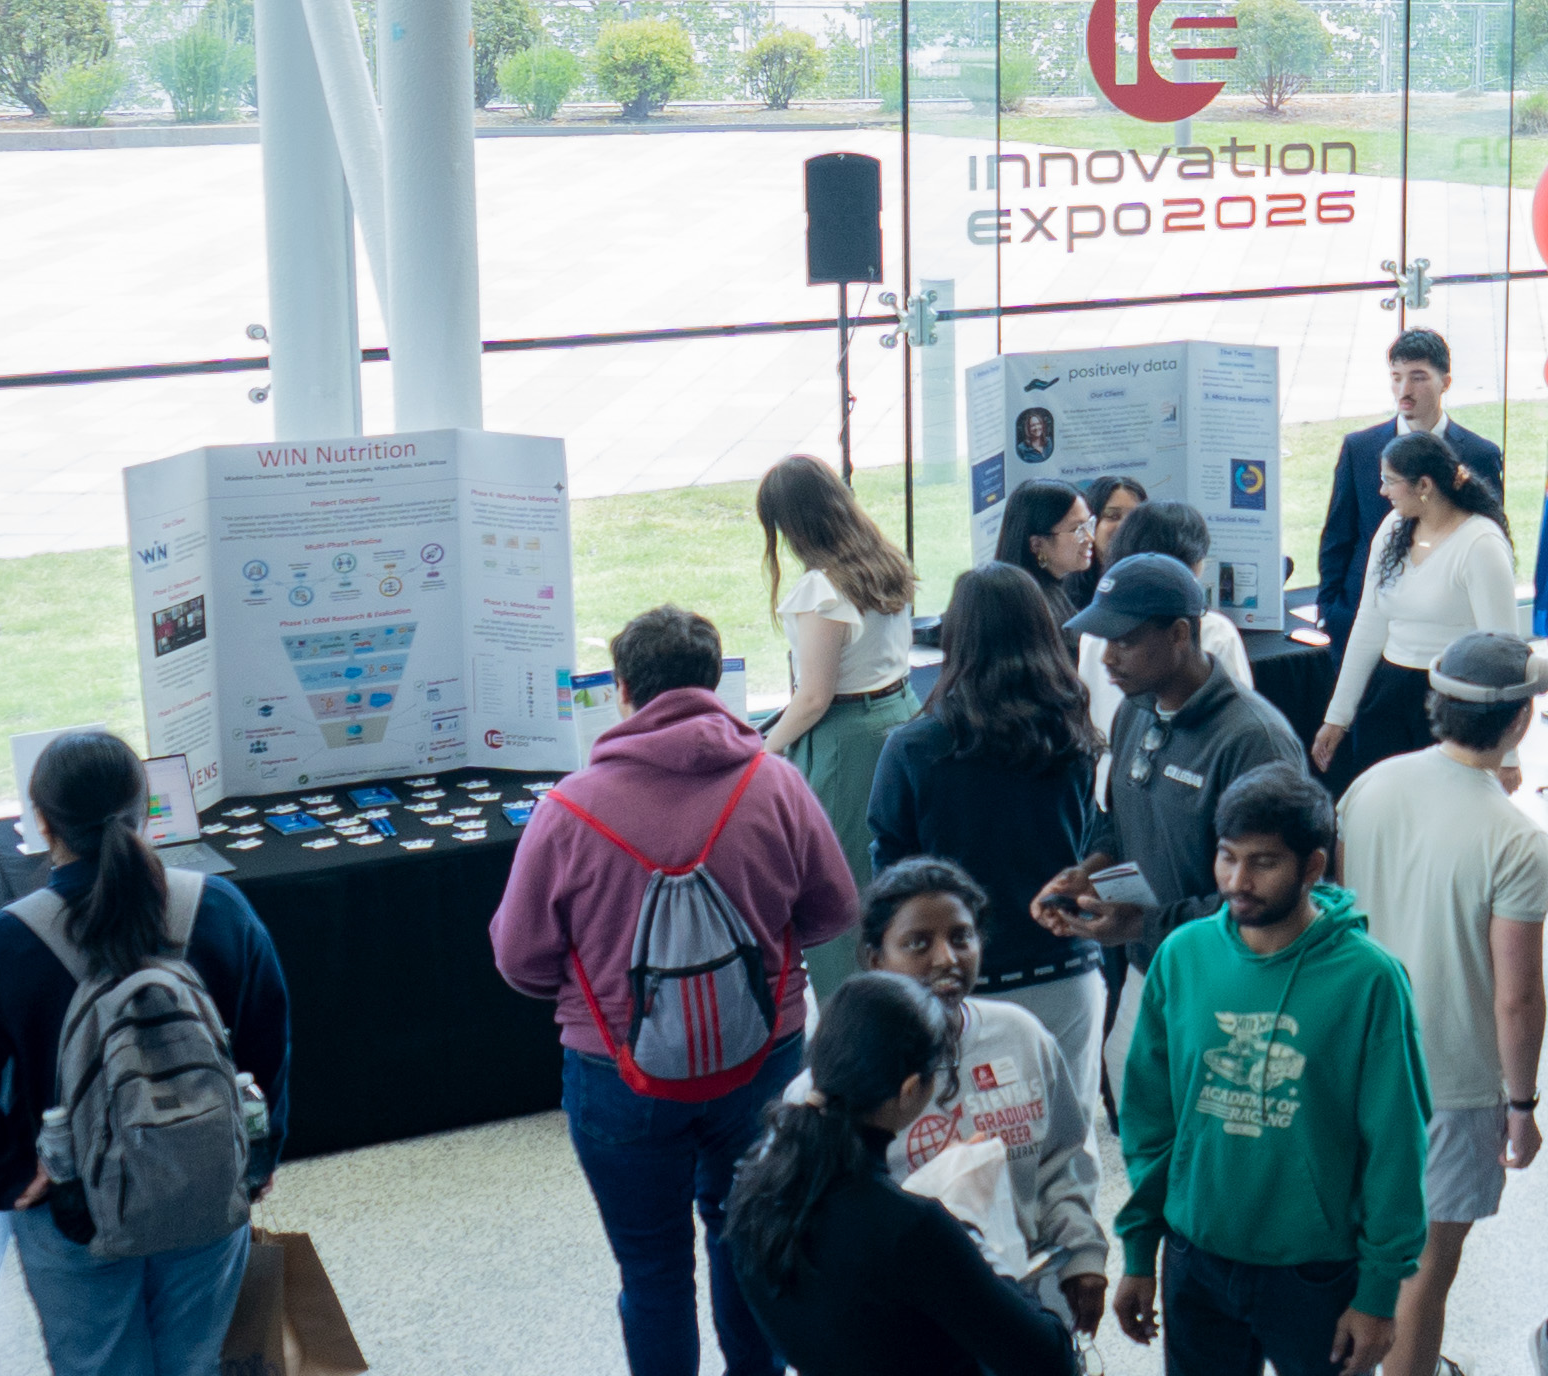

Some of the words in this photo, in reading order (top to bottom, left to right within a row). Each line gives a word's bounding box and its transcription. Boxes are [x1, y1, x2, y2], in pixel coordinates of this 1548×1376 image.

[968, 137, 1357, 191] innovation
[967, 190, 1356, 253] expo2026
[1068, 361, 1139, 382] positively
[1143, 359, 1177, 372] data
[1104, 389, 1124, 398] Client
[258, 447, 308, 468] WIN
[316, 442, 417, 464] Nutrition
[1061, 468, 1074, 476] Key
[1076, 464, 1100, 475] Project
[973, 1098, 1044, 1132] GRADUATE
[1228, 1105, 1293, 1129] RACNG
[1277, 1098, 1301, 1115] OF
